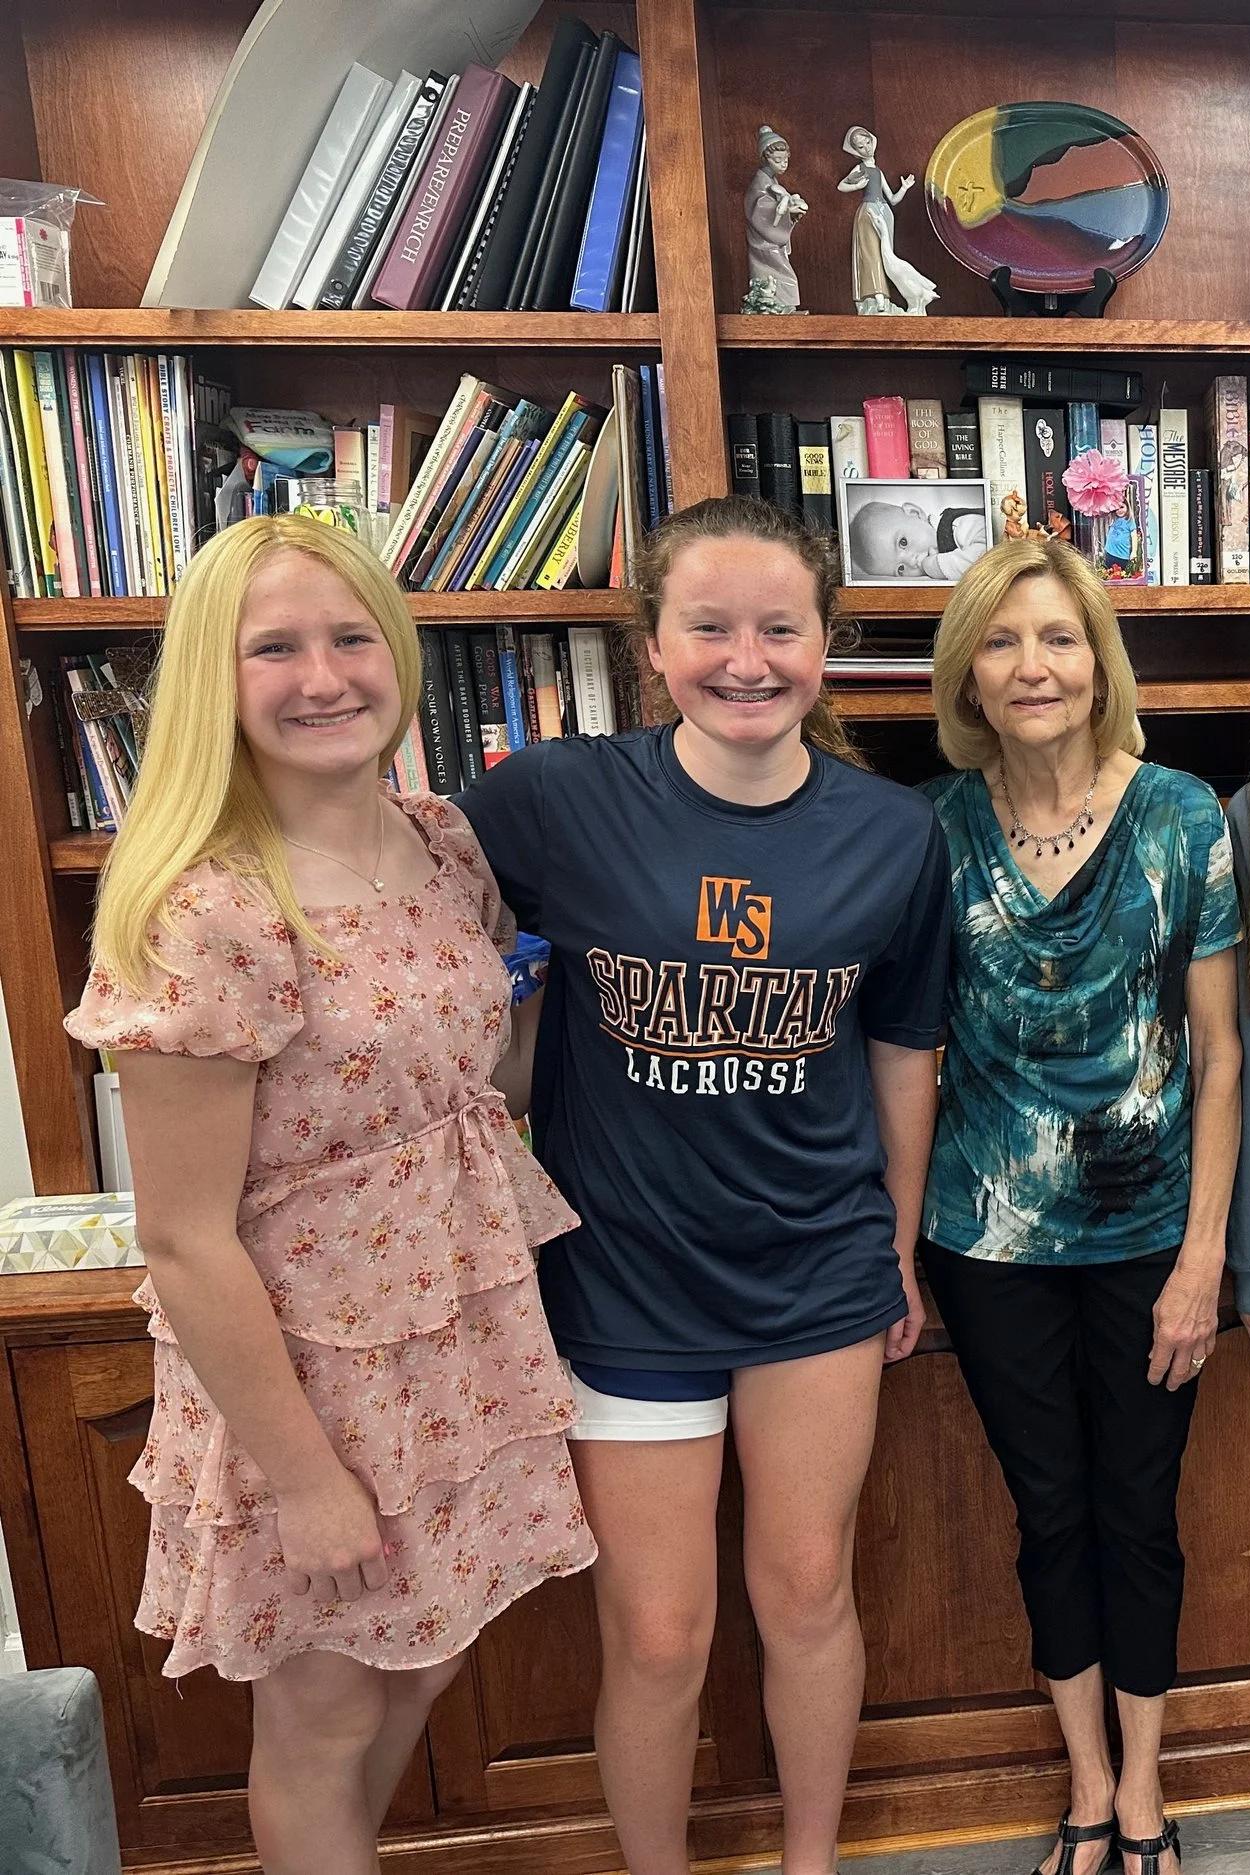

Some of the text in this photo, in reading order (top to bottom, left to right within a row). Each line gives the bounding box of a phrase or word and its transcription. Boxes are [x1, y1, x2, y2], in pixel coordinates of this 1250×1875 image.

[400, 107, 471, 264] PREPARE/ENRICH
[161, 388, 169, 413] STORY
[163, 416, 172, 445] CRAFTS
[911, 420, 939, 428] BOOK
[915, 440, 938, 449] GOD
[919, 430, 930, 438] OF
[1163, 430, 1183, 441] The
[996, 424, 1006, 477] HarperCollins
[1137, 425, 1156, 483] HOLY
[1163, 443, 1186, 490] MESSAGE
[167, 455, 175, 493] PROJECTS
[1044, 471, 1054, 496] HOLY
[1170, 502, 1179, 542] PETERSON
[473, 645, 490, 715] GODS PEACE
[485, 648, 501, 708] GODS WAR
[504, 657, 514, 678] World
[452, 643, 472, 743] AFTER THE BABY BOOMERS
[506, 679, 517, 708] Religions
[582, 649, 598, 730] DICTIONARY OF SAINTS
[425, 679, 446, 784] IN OUR OWN VOICES
[510, 716, 521, 744] America
[705, 880, 767, 956] WS
[586, 947, 860, 1048] SPARTAN
[625, 1047, 805, 1095] LACROSSE
